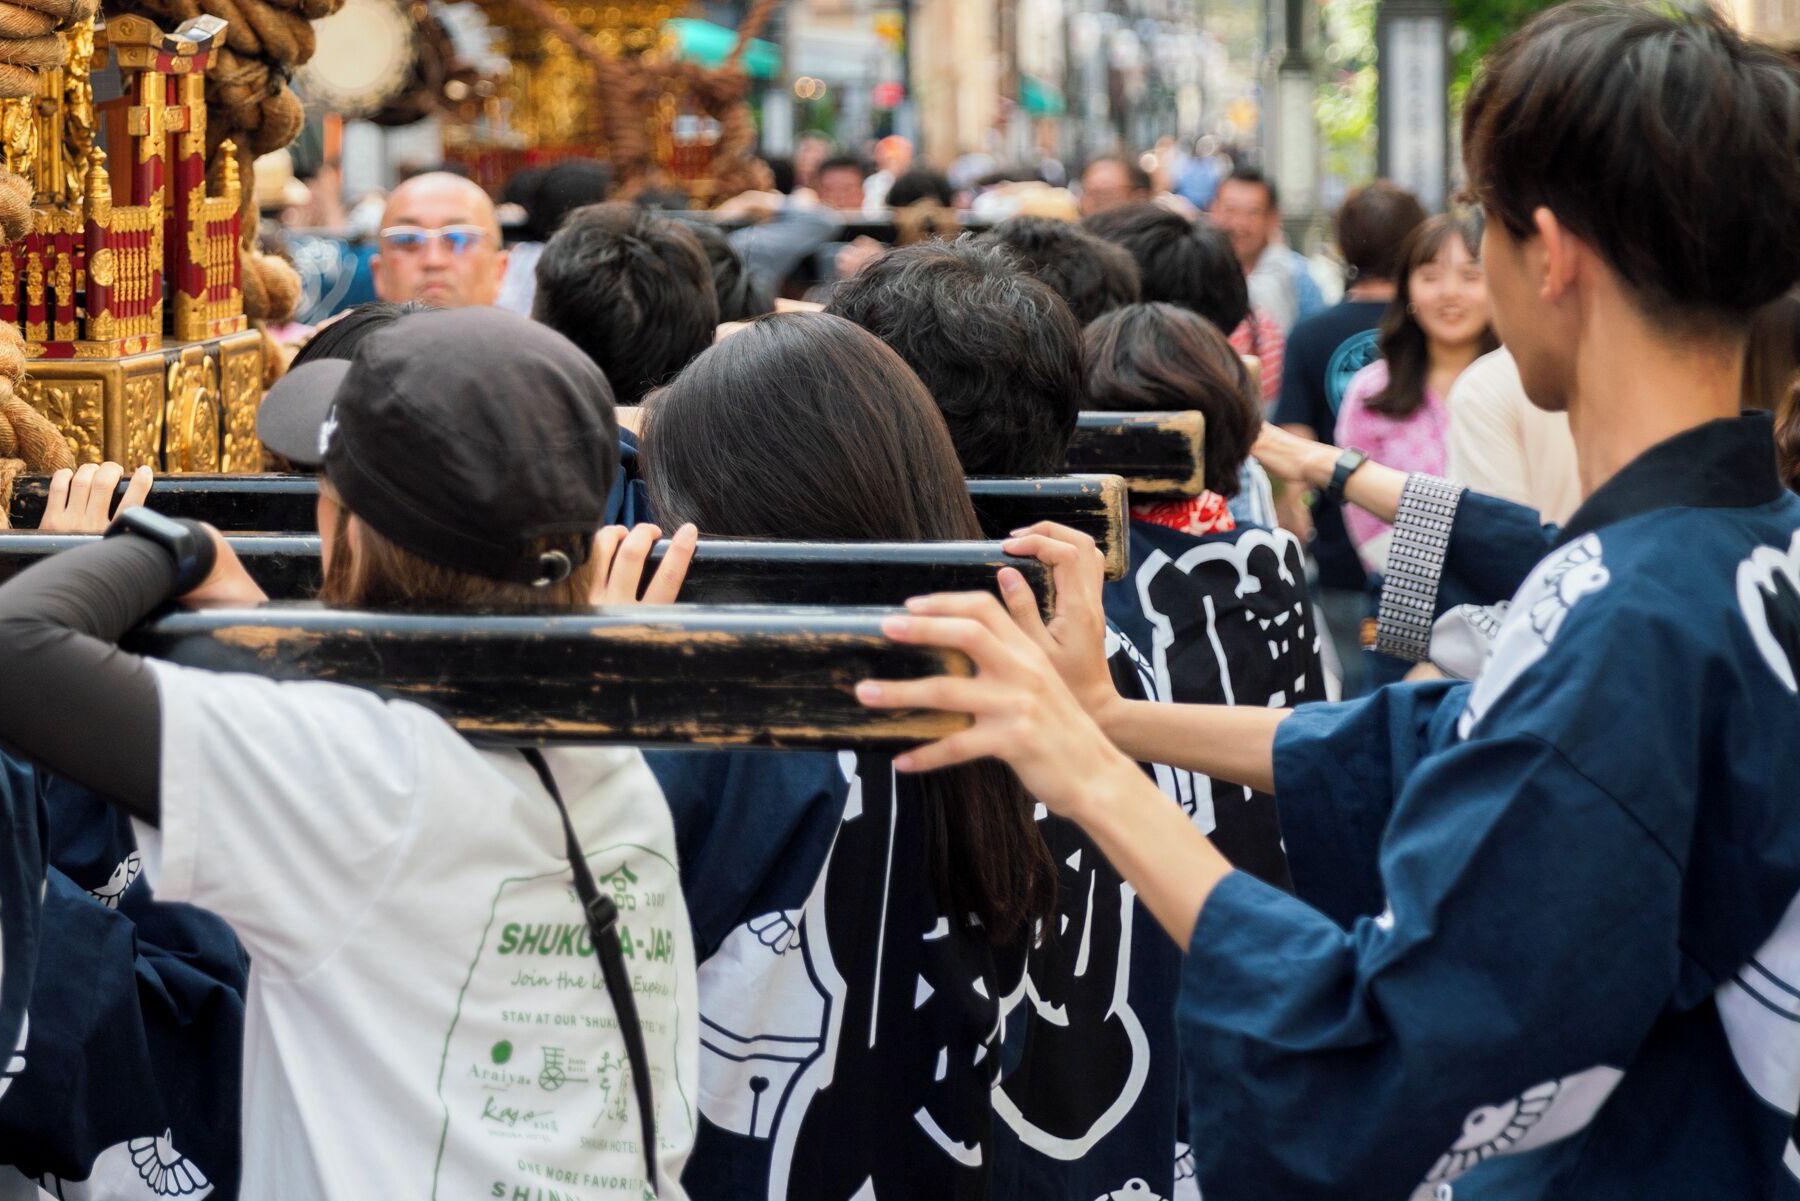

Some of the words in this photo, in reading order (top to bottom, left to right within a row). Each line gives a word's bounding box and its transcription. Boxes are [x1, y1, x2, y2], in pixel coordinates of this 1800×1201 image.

[511, 968, 552, 987] Join
[556, 971, 586, 990] the
[501, 1010, 531, 1024] STAY
[535, 1012, 550, 1025] AT
[553, 1014, 577, 1027] OUR
[518, 1159, 542, 1176] ONE
[546, 1166, 578, 1185] MORE
